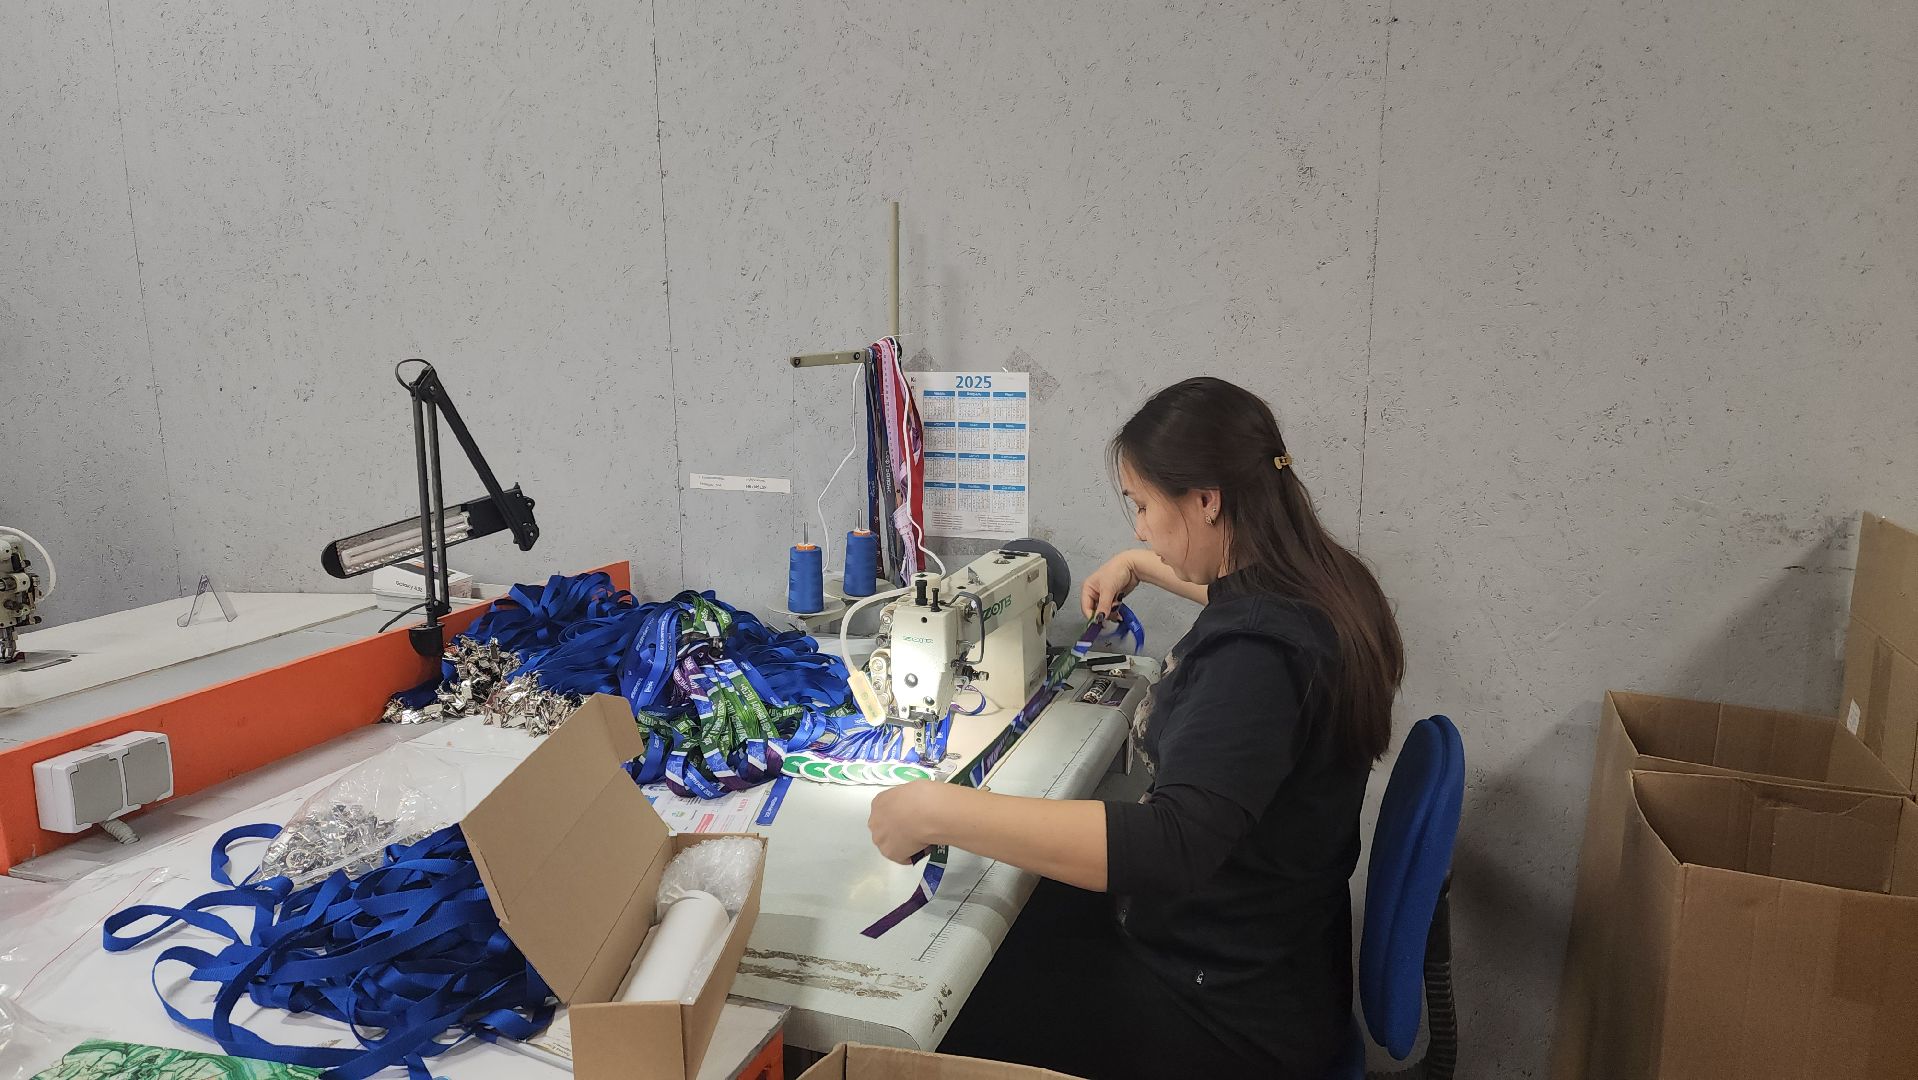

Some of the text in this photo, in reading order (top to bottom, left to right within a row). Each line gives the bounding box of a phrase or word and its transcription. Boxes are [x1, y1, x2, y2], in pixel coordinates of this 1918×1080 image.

[955, 375, 992, 389] 2025
[396, 580, 413, 590] Galaxy
[983, 594, 1012, 621] ZOJE
[902, 635, 934, 644] ZOJE
